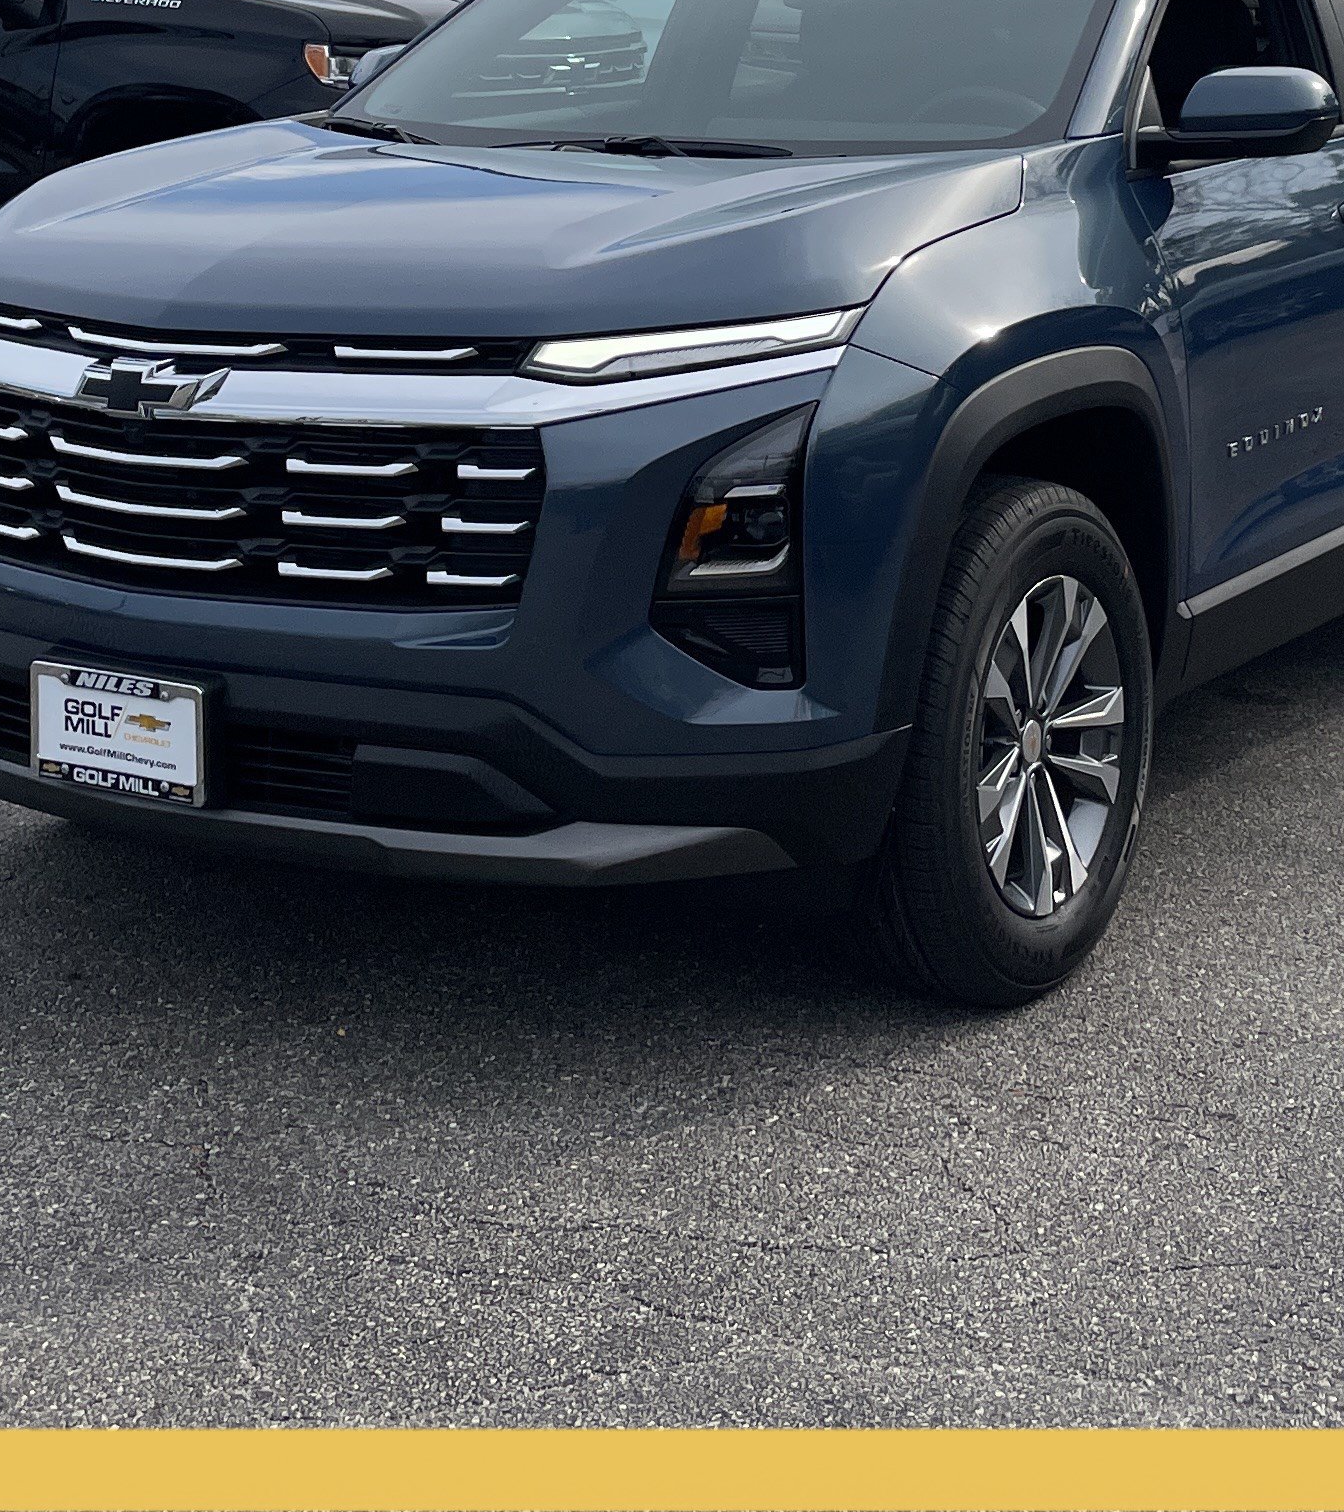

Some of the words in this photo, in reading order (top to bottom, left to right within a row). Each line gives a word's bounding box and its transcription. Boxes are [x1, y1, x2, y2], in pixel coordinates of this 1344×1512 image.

[75, 671, 154, 697] NILES
[64, 698, 123, 722] GOLF
[64, 715, 112, 739] MILL
[59, 742, 177, 771] www.GolfMillChevy.com
[72, 767, 118, 788] GOLF
[118, 774, 160, 797] MILL
